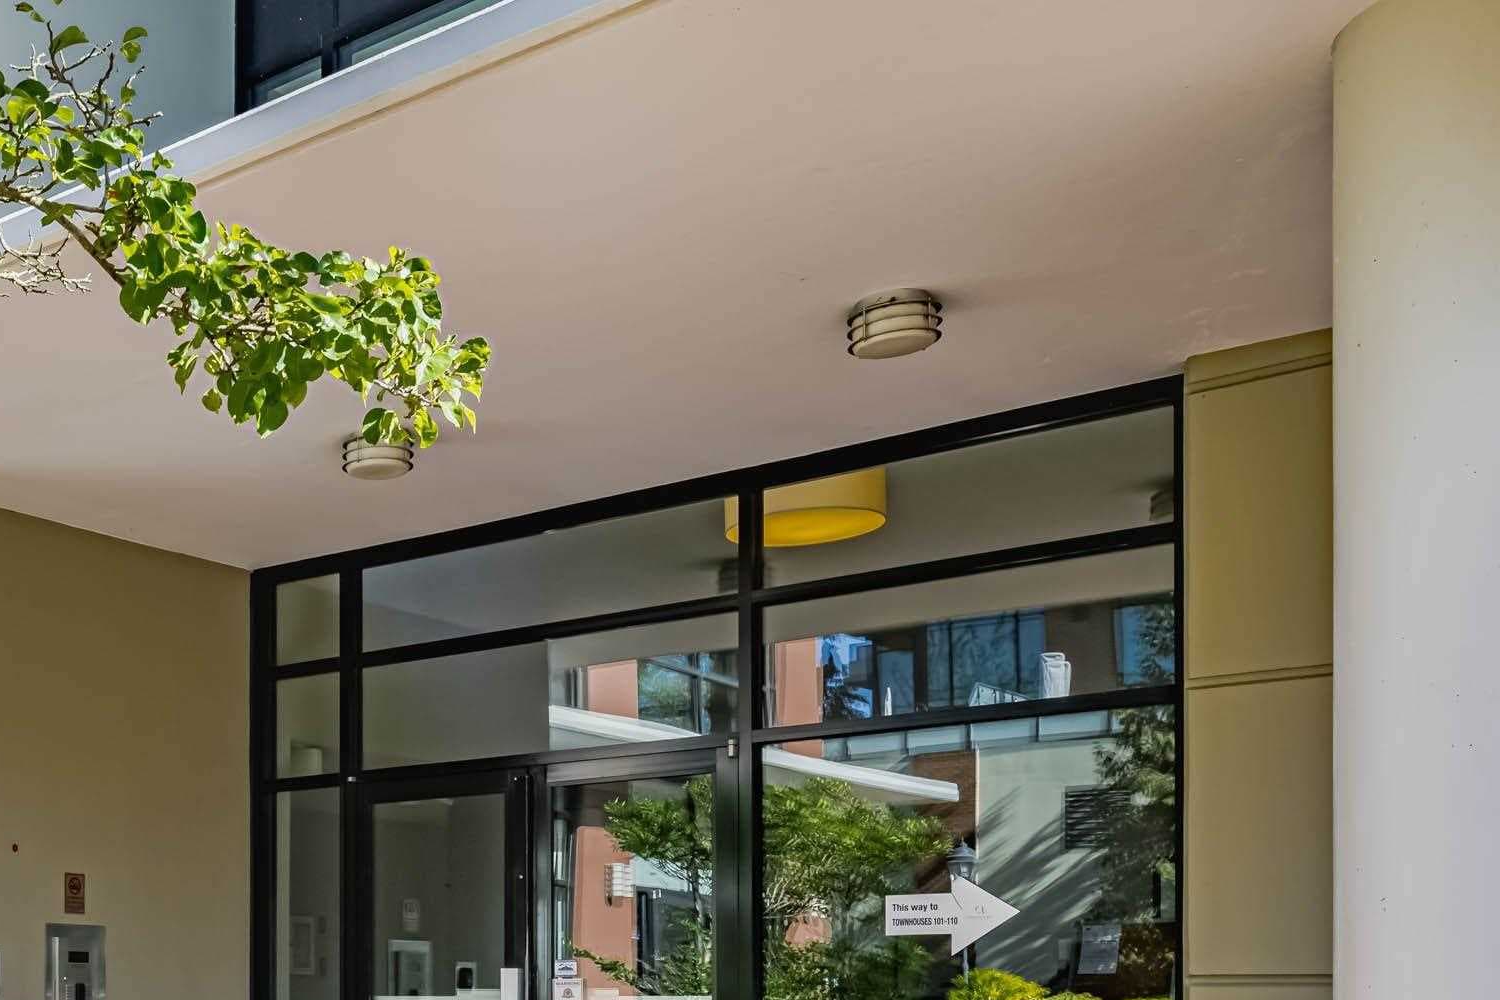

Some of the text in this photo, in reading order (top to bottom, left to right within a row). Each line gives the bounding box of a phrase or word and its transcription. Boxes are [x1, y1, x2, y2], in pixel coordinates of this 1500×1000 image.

[892, 902, 938, 912] This way to
[892, 917, 958, 926] TOWNHOUSES 101-110
